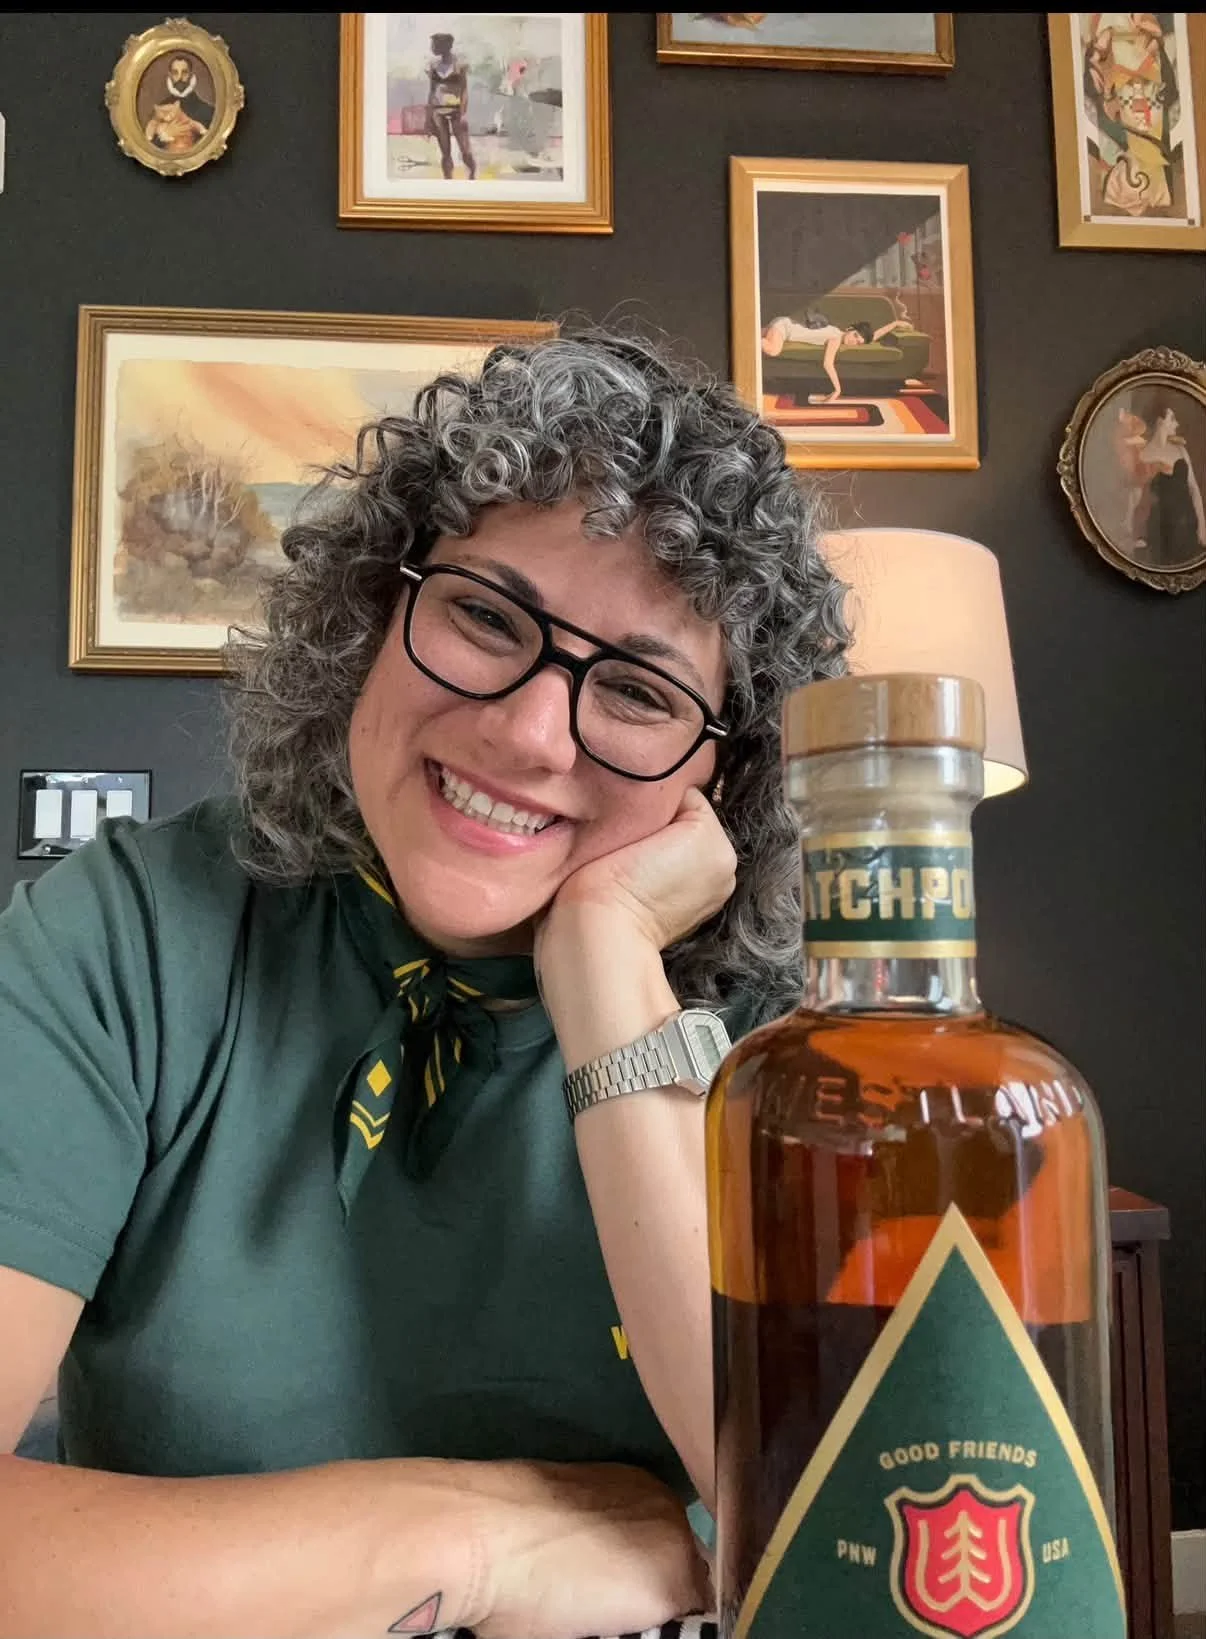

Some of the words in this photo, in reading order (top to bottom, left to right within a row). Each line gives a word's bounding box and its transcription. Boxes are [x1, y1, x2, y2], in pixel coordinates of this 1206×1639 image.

[803, 867, 975, 920] ATCHPO
[879, 1441, 940, 1470] GOOD
[948, 1440, 1037, 1469] FRIENDS
[836, 1539, 878, 1567] PNW
[1041, 1537, 1070, 1563] USA
